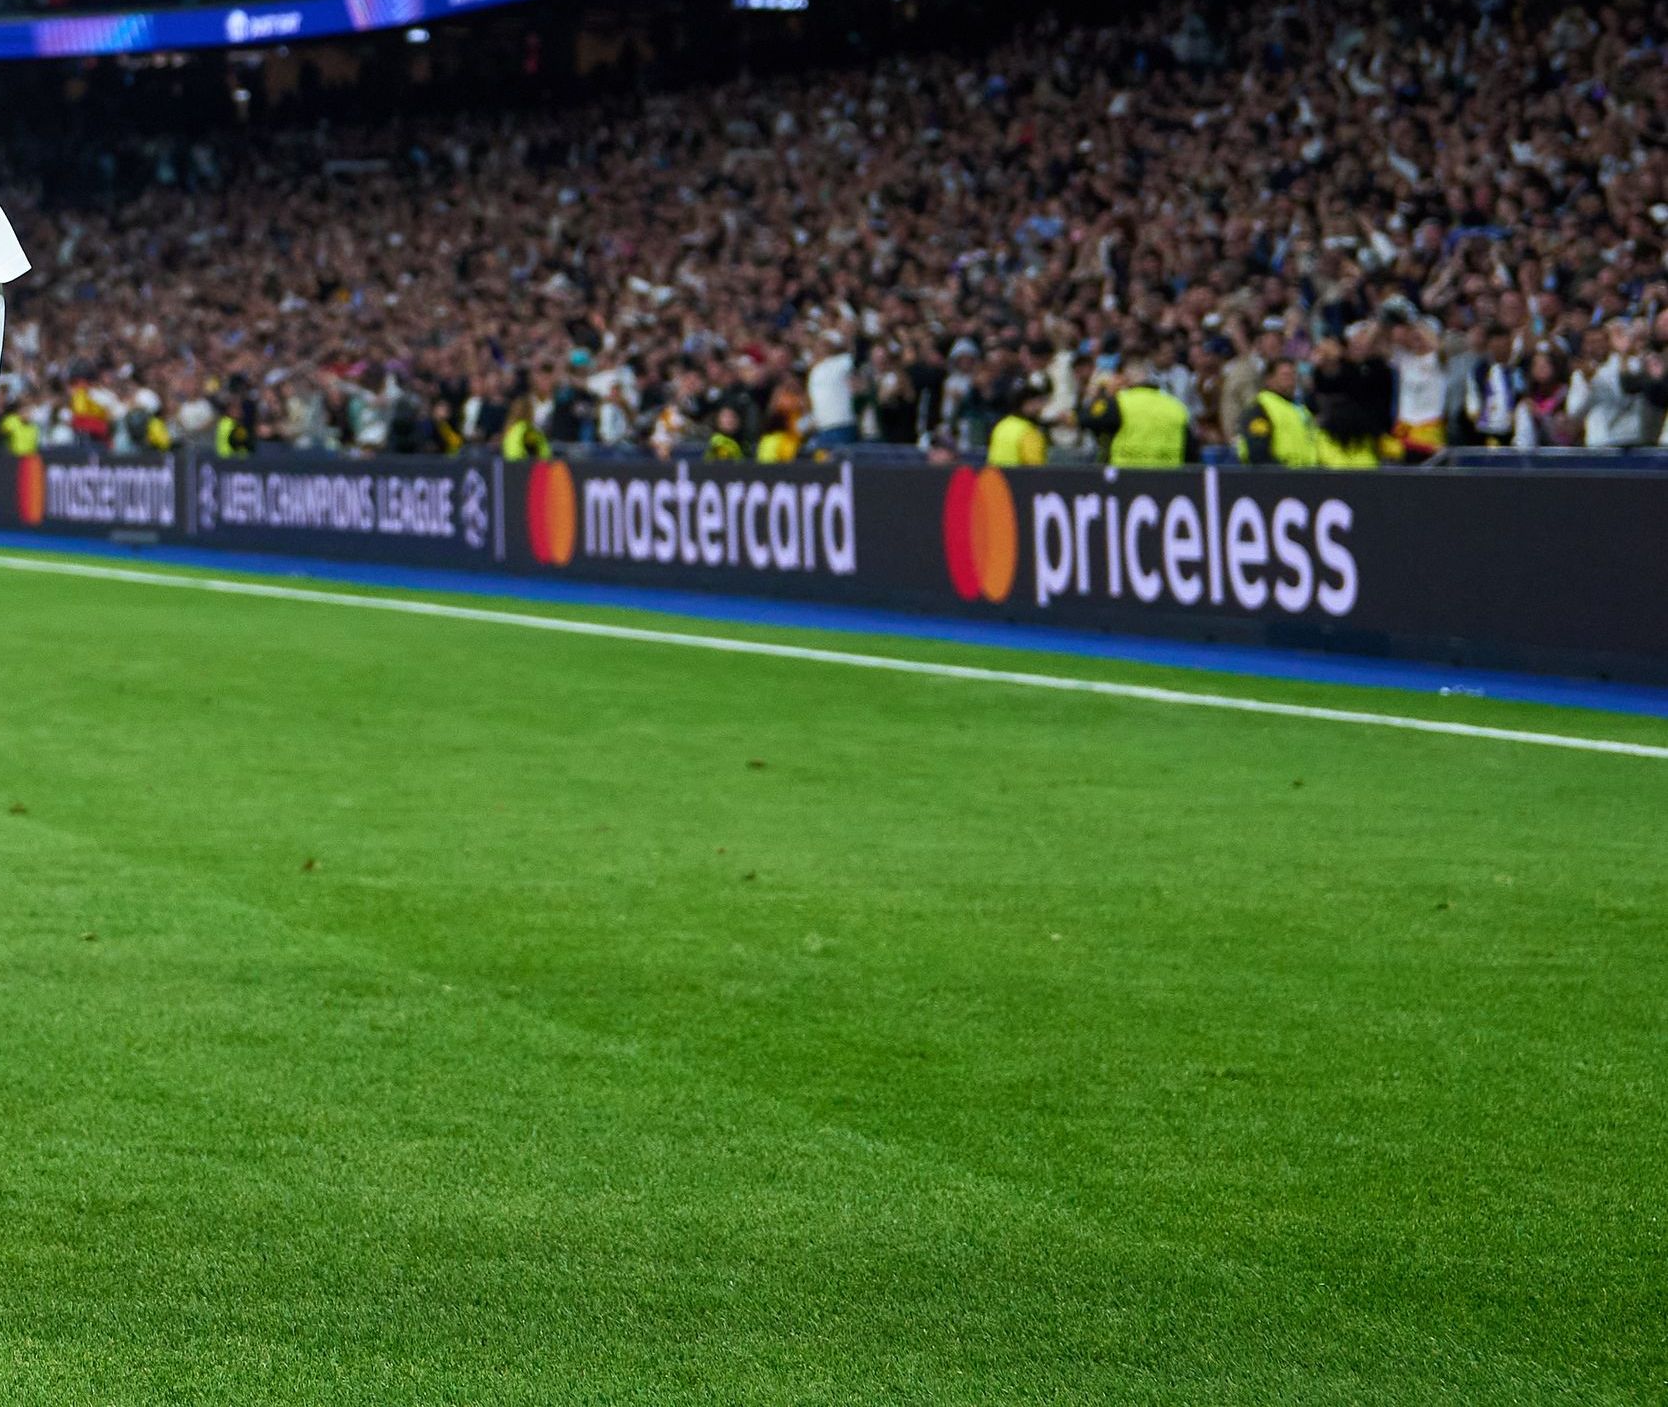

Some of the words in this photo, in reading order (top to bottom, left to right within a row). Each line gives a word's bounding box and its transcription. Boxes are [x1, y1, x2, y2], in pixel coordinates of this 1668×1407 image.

[220, 470, 263, 525] UEFA
[266, 472, 374, 531] CHAMPIONS
[377, 475, 455, 537] LEAGUE
[583, 458, 857, 575] mastercard
[1033, 465, 1359, 617] priceless
